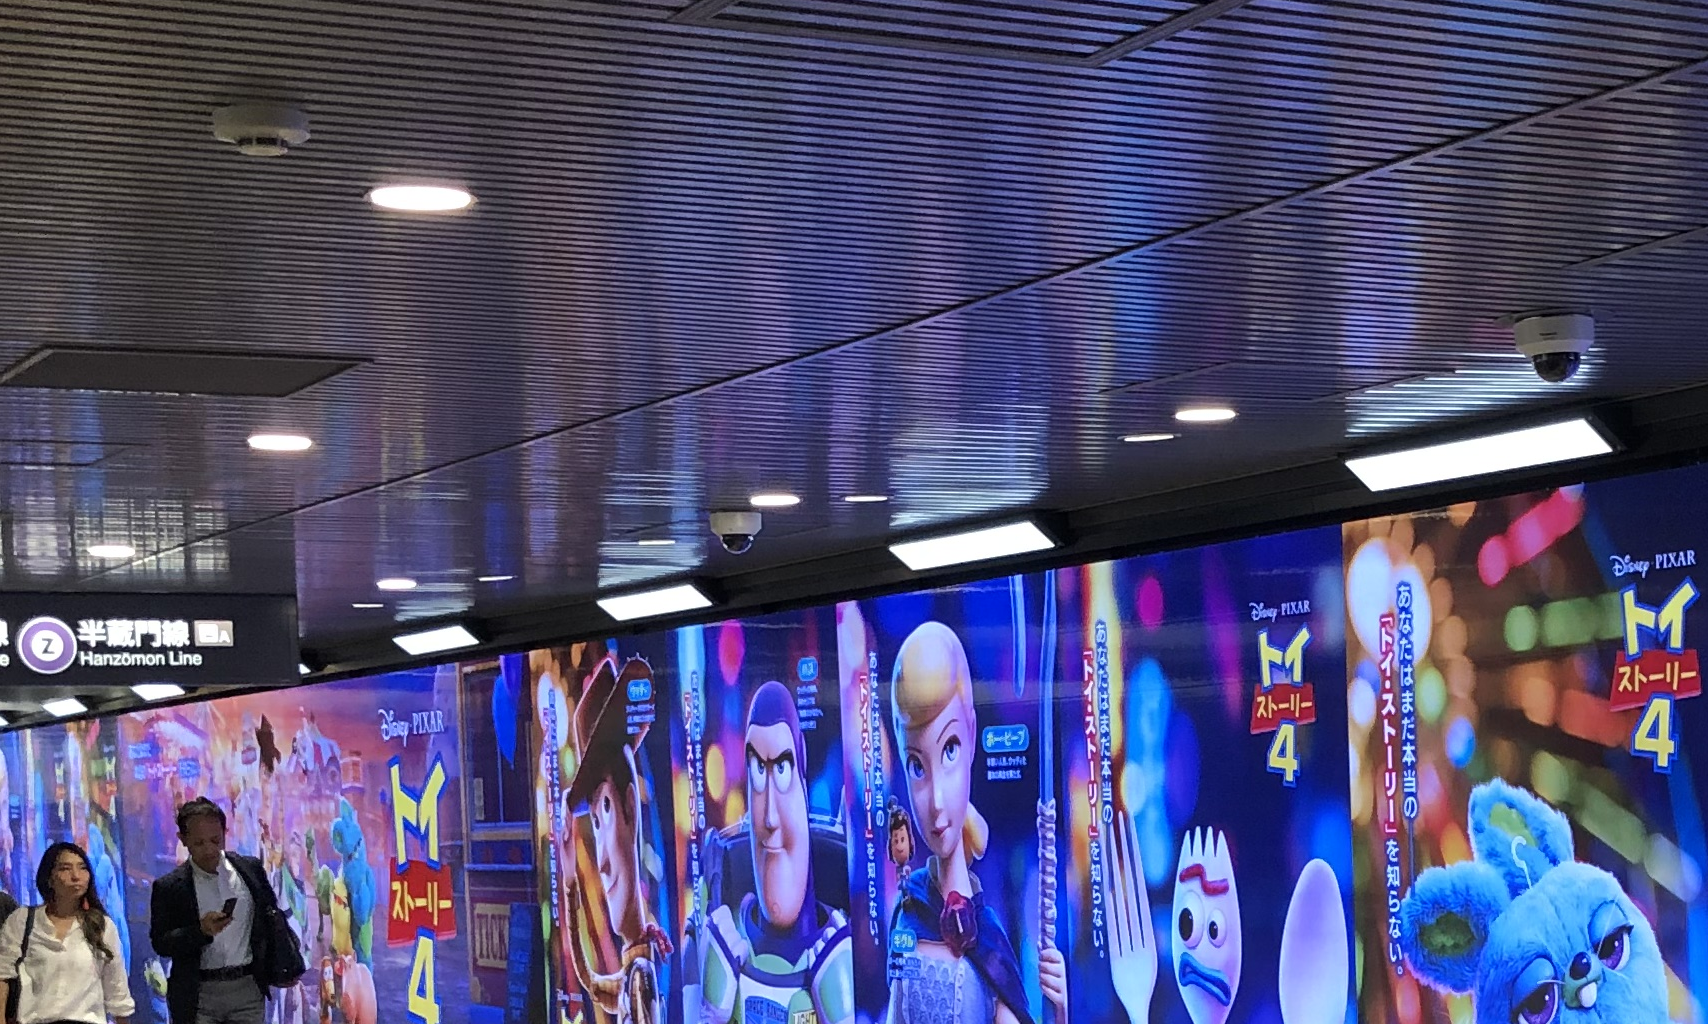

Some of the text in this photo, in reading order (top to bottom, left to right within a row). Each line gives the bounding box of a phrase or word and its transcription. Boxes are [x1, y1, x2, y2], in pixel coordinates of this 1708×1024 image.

[1655, 549, 1696, 569] PIXAR
[1281, 600, 1311, 615] PIXAR
[77, 618, 191, 648] 半蔵門線
[41, 638, 55, 654] Z
[169, 651, 203, 666] Line
[1618, 662, 1697, 692] ストーリー
[1257, 693, 1313, 718] ストーリー
[412, 710, 445, 735] PIXAR
[1631, 693, 1679, 773] 4
[1267, 719, 1300, 788] 4
[391, 880, 452, 926] ストーリー
